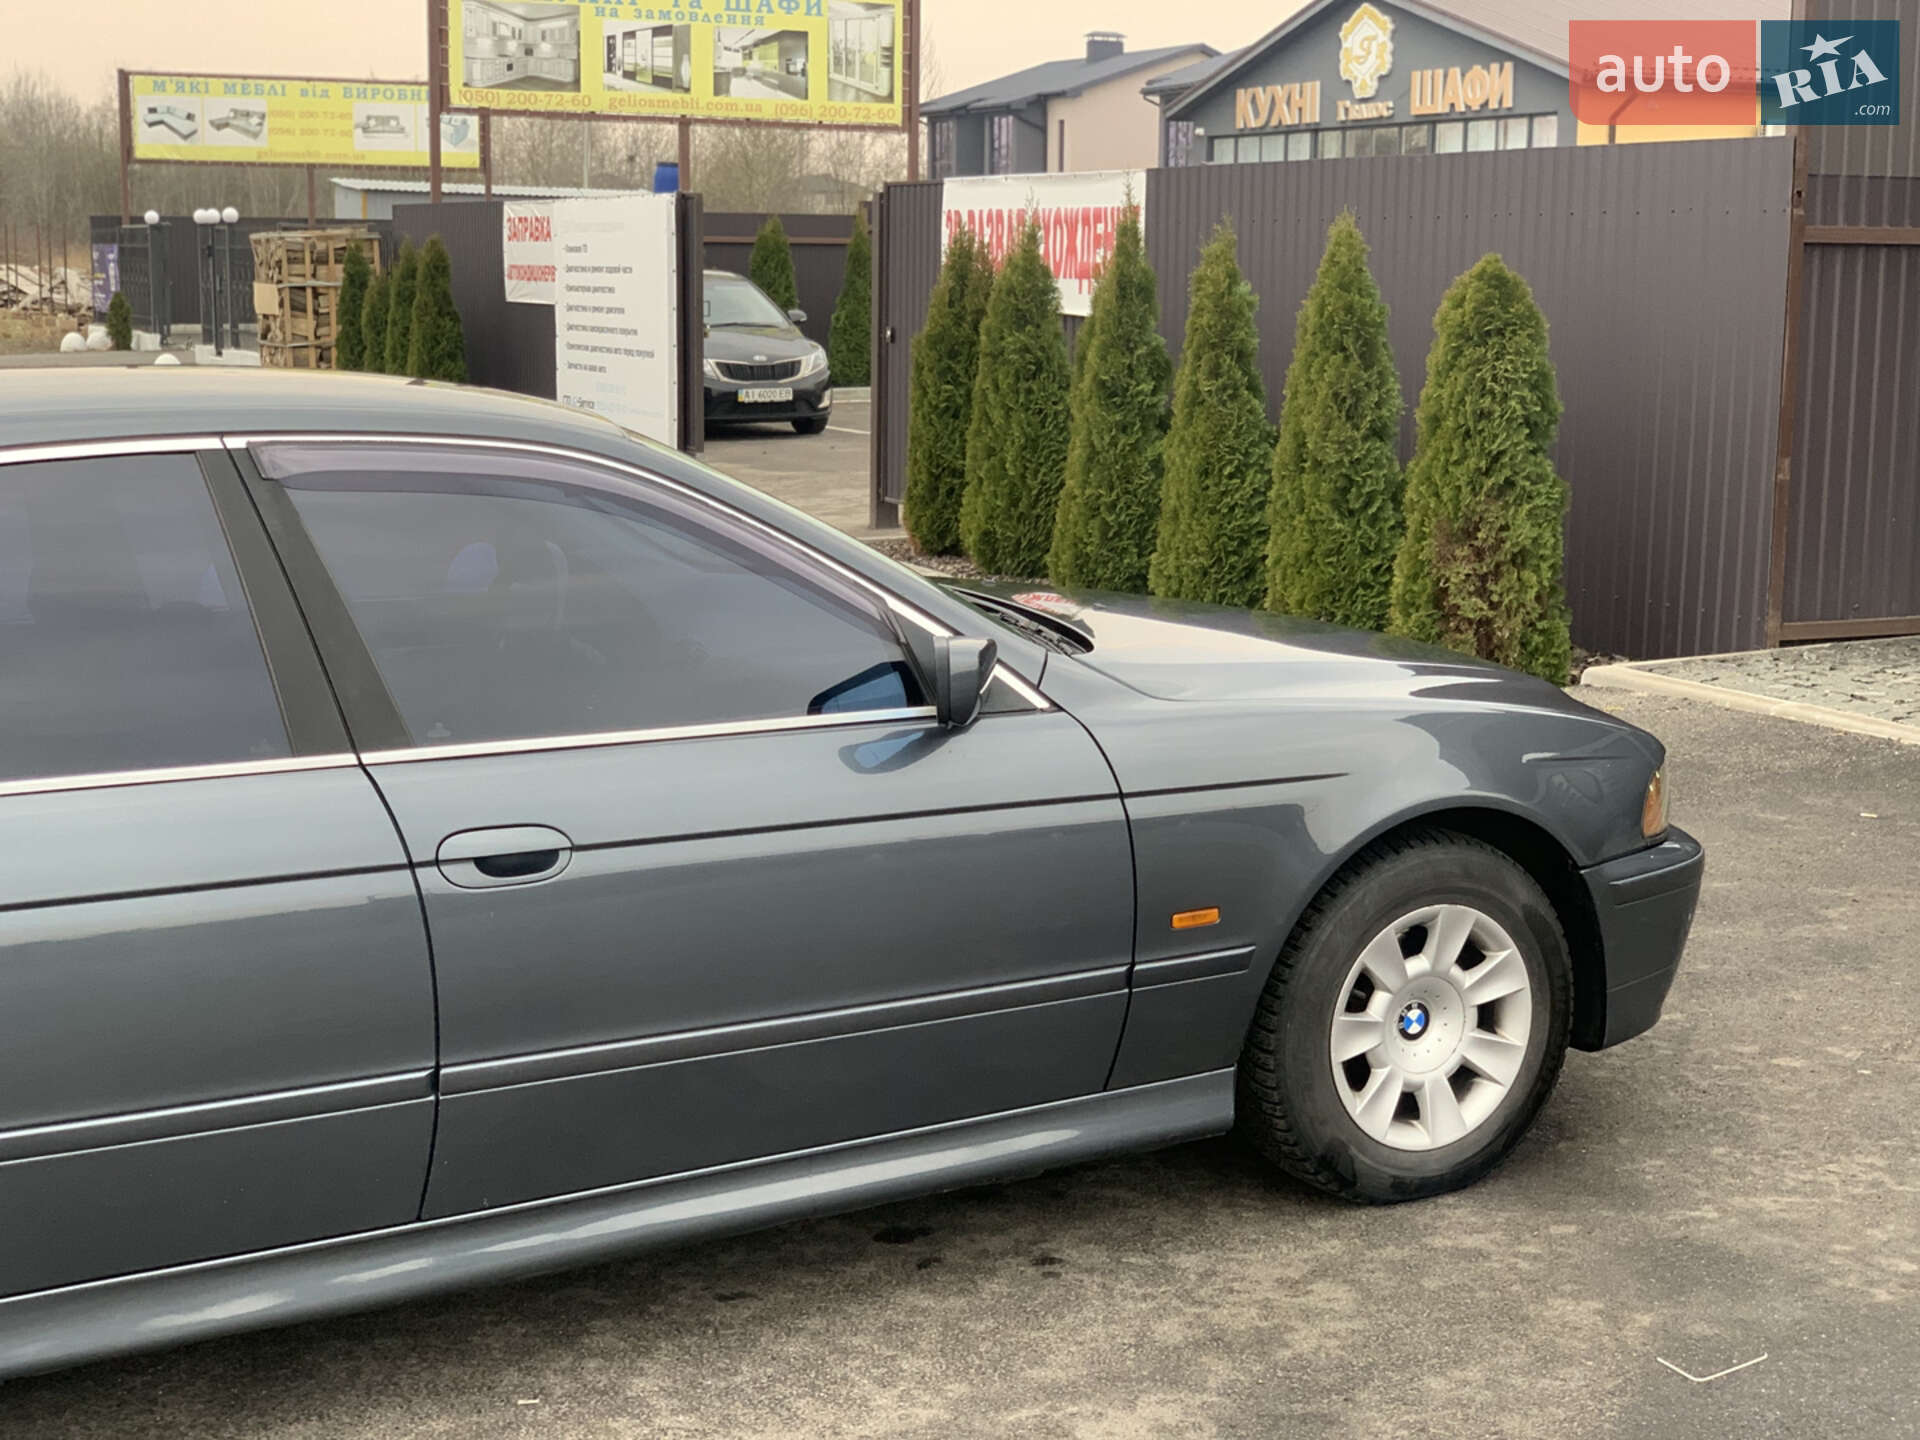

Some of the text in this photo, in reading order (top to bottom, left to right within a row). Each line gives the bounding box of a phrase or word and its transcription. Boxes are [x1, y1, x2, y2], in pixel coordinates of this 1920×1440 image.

[595, 6, 765, 26] на замовлення
[152, 79, 210, 95] М'ЯКІ
[223, 82, 287, 97] МЕБЛІ
[300, 84, 329, 98] від
[1235, 61, 1514, 129] КУХНІ ШАФИ
[506, 91, 592, 108] 200-72-60
[608, 94, 763, 114] geliosmebli.com.ua
[818, 104, 896, 120] 200-72-60
[506, 215, 553, 242] ЗАПРАВКА
